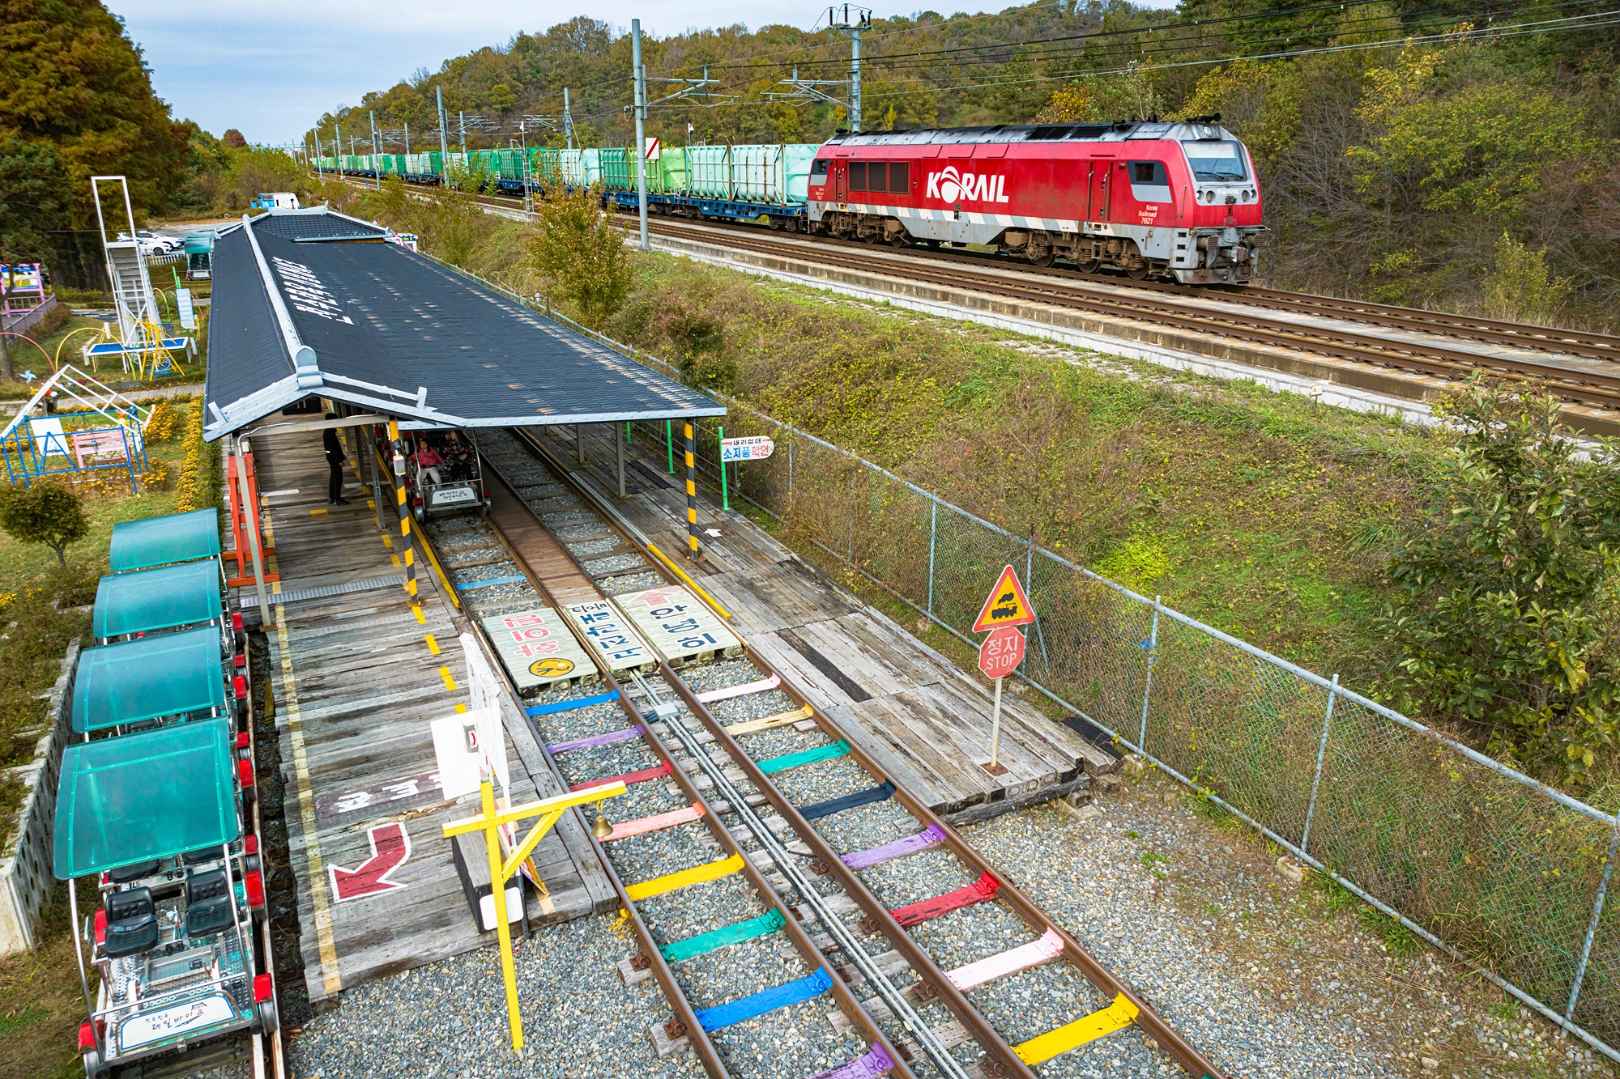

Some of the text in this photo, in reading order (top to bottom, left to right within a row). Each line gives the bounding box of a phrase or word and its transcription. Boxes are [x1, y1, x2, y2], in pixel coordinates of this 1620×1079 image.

[926, 166, 1009, 203] KORAIL
[987, 636, 1018, 655] 정지
[986, 654, 1017, 670] STOP
